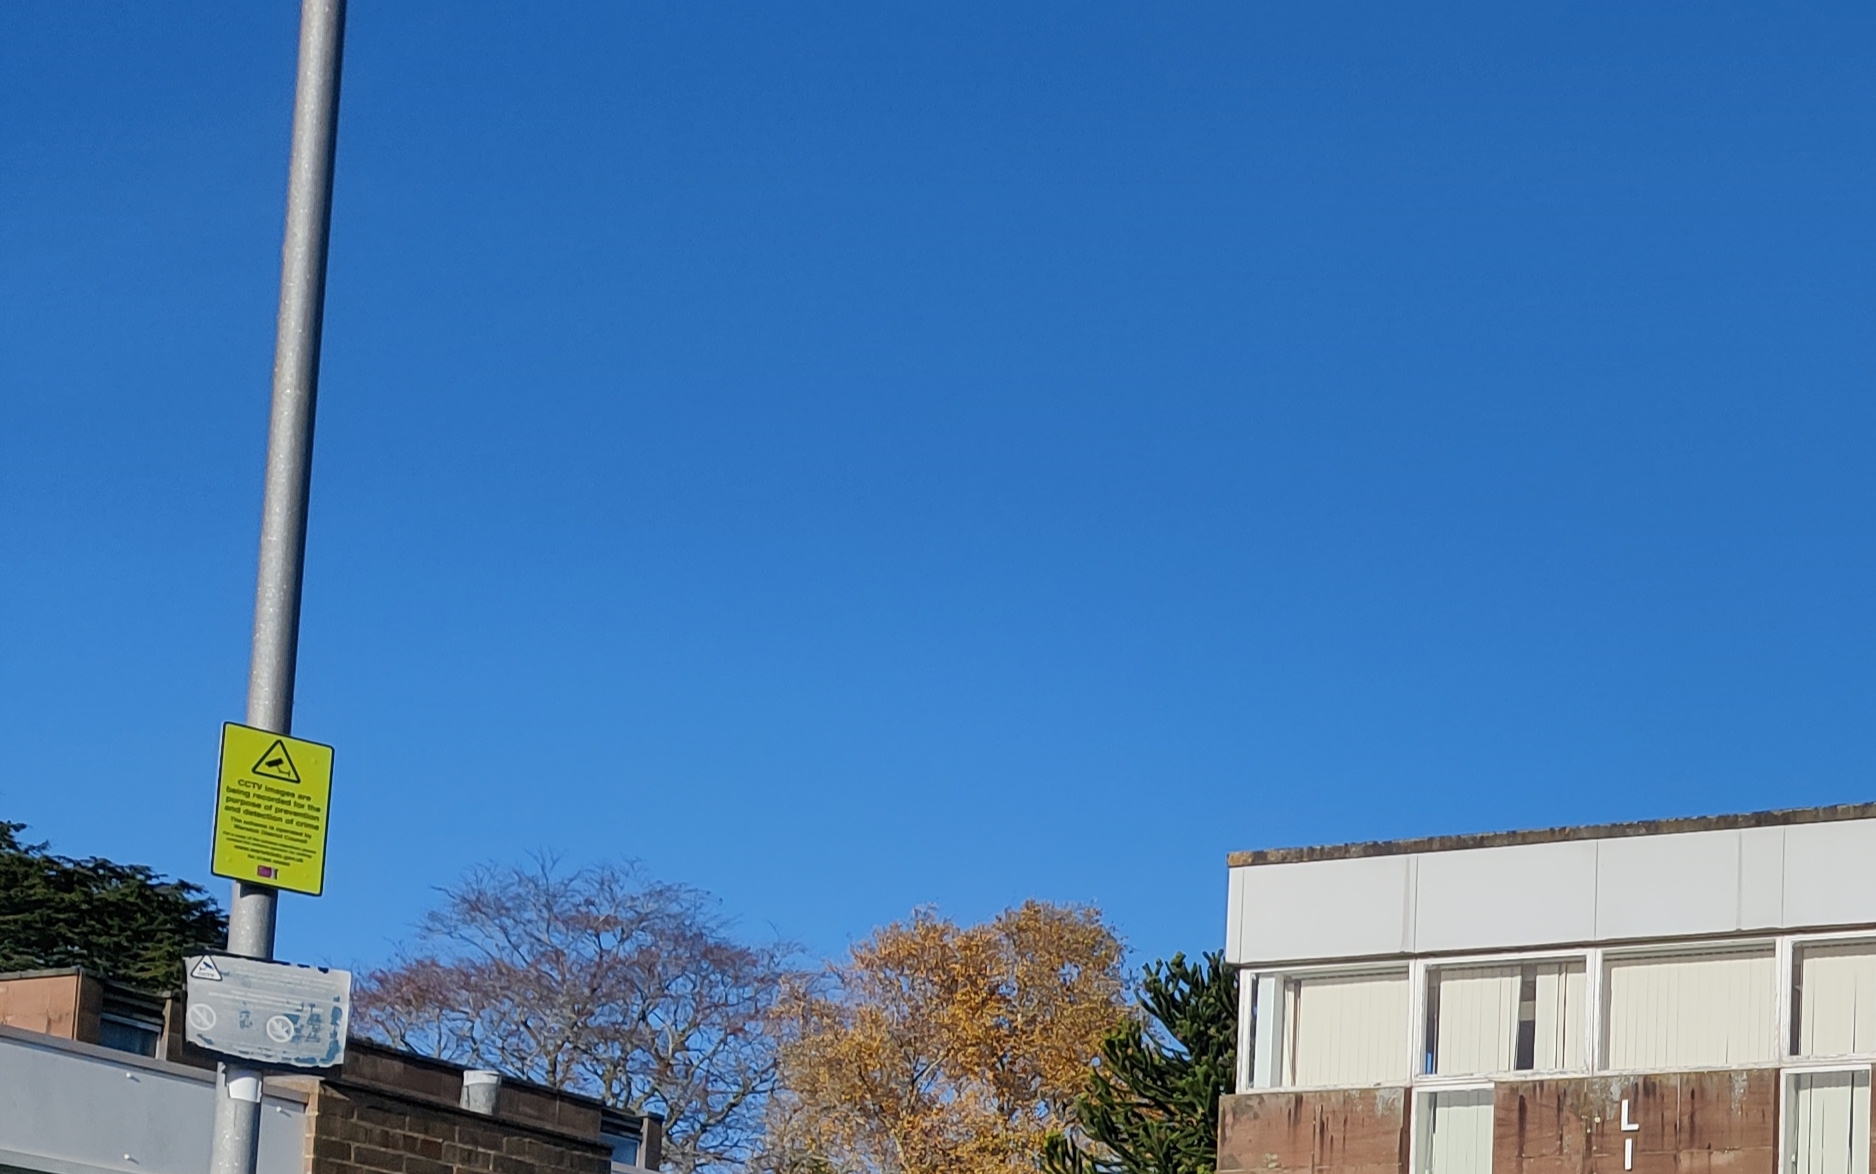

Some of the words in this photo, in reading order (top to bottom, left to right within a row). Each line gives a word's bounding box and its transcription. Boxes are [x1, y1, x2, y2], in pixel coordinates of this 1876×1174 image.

[226, 785, 250, 798] being
[253, 793, 291, 806] recorded
[293, 800, 304, 808] for
[308, 804, 321, 813] the
[238, 779, 262, 790] CCTV
[265, 785, 295, 798] images
[298, 794, 311, 802] are
[224, 805, 241, 813] and
[243, 809, 282, 822] detection
[296, 821, 319, 830] crime
[226, 796, 261, 808] purpose
[275, 807, 319, 821] prevention
